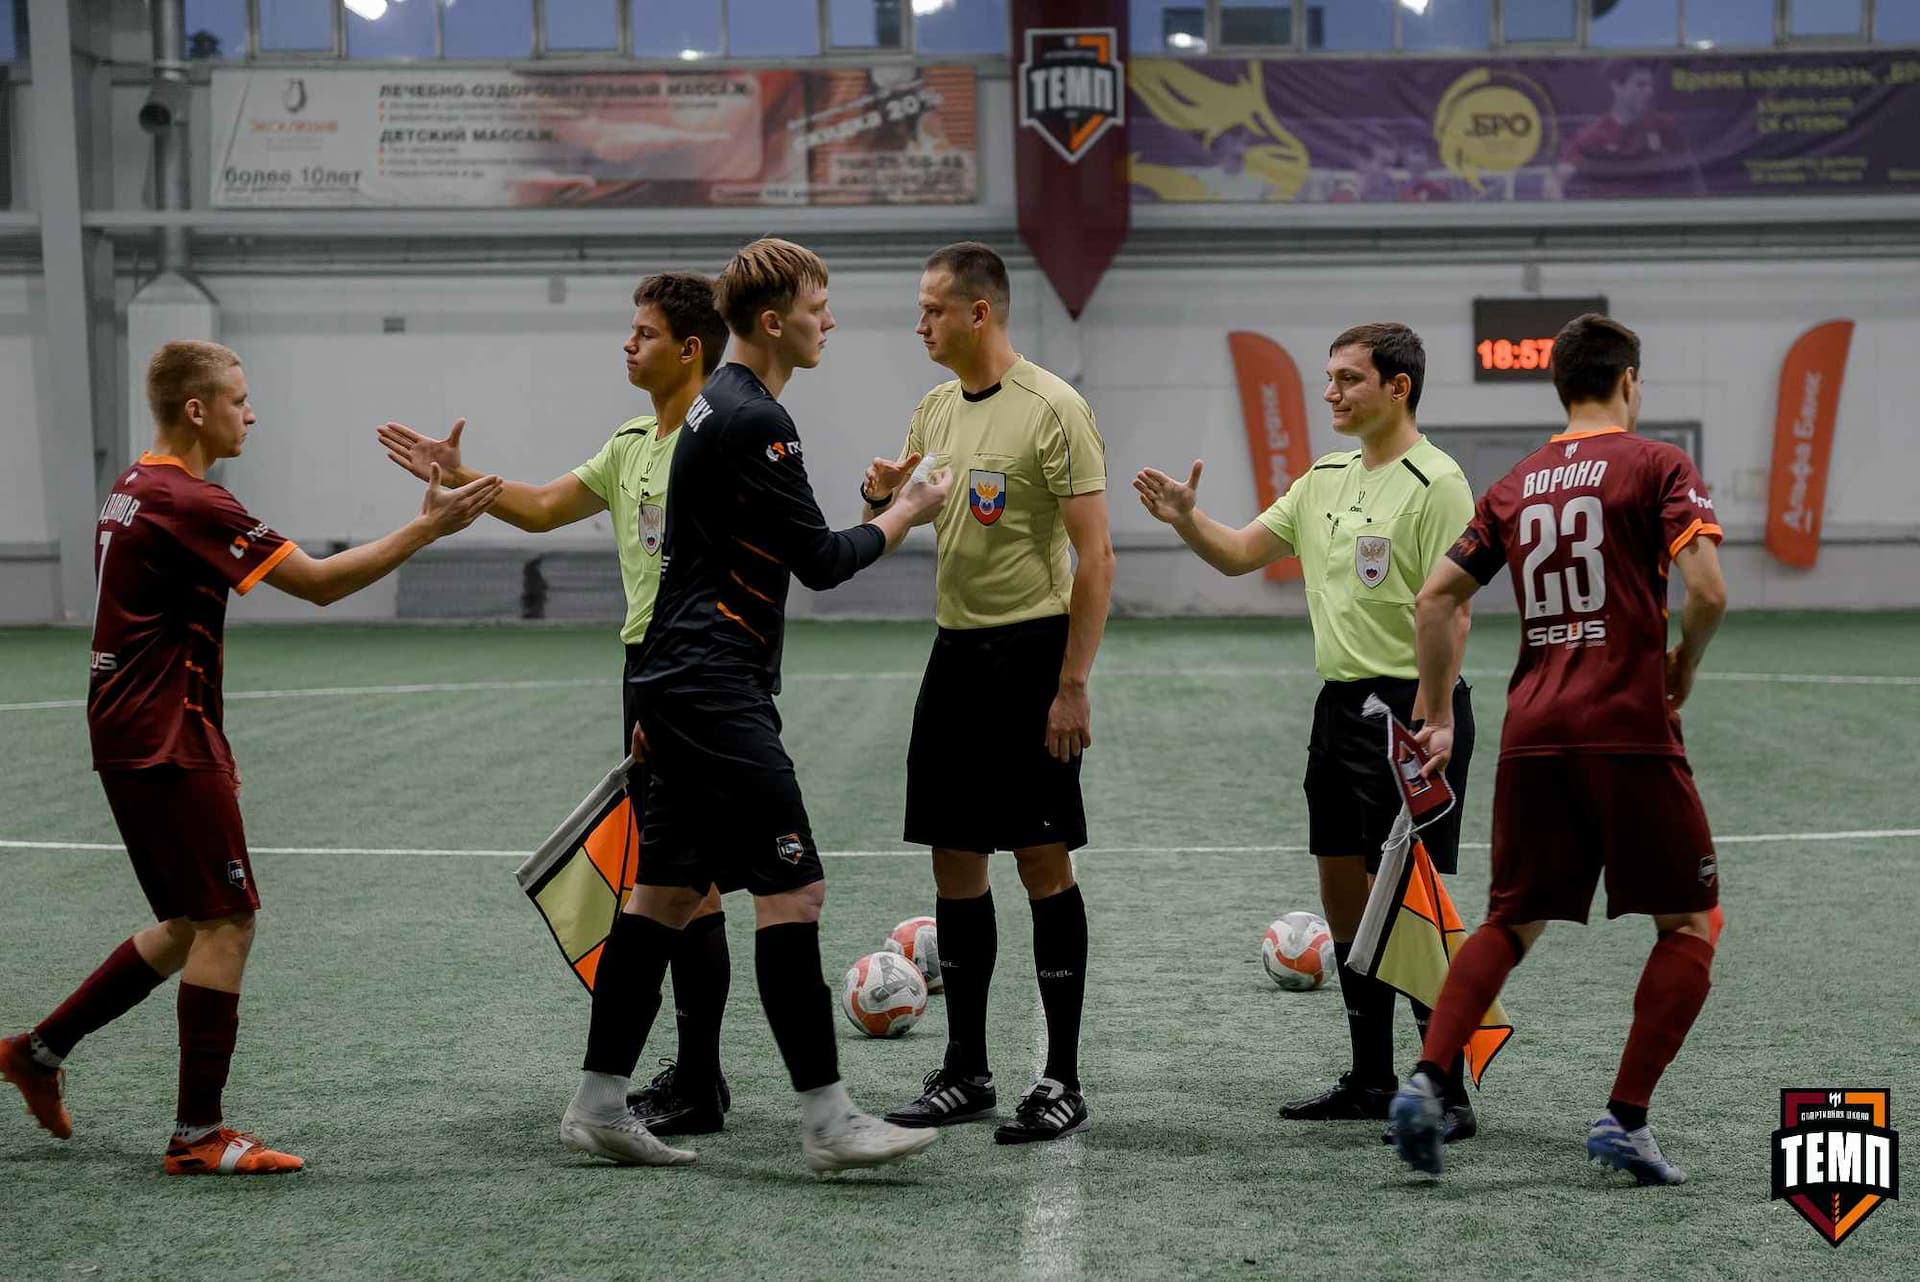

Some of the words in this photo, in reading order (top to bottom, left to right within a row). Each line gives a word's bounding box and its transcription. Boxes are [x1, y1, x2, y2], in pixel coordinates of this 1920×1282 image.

[1030, 65, 1114, 111] ТЕМП
[1476, 338, 1556, 370] 18:57
[1522, 460, 1608, 499] ВОРОНА
[1519, 495, 1606, 620] 23
[1527, 619, 1607, 647] SEUS
